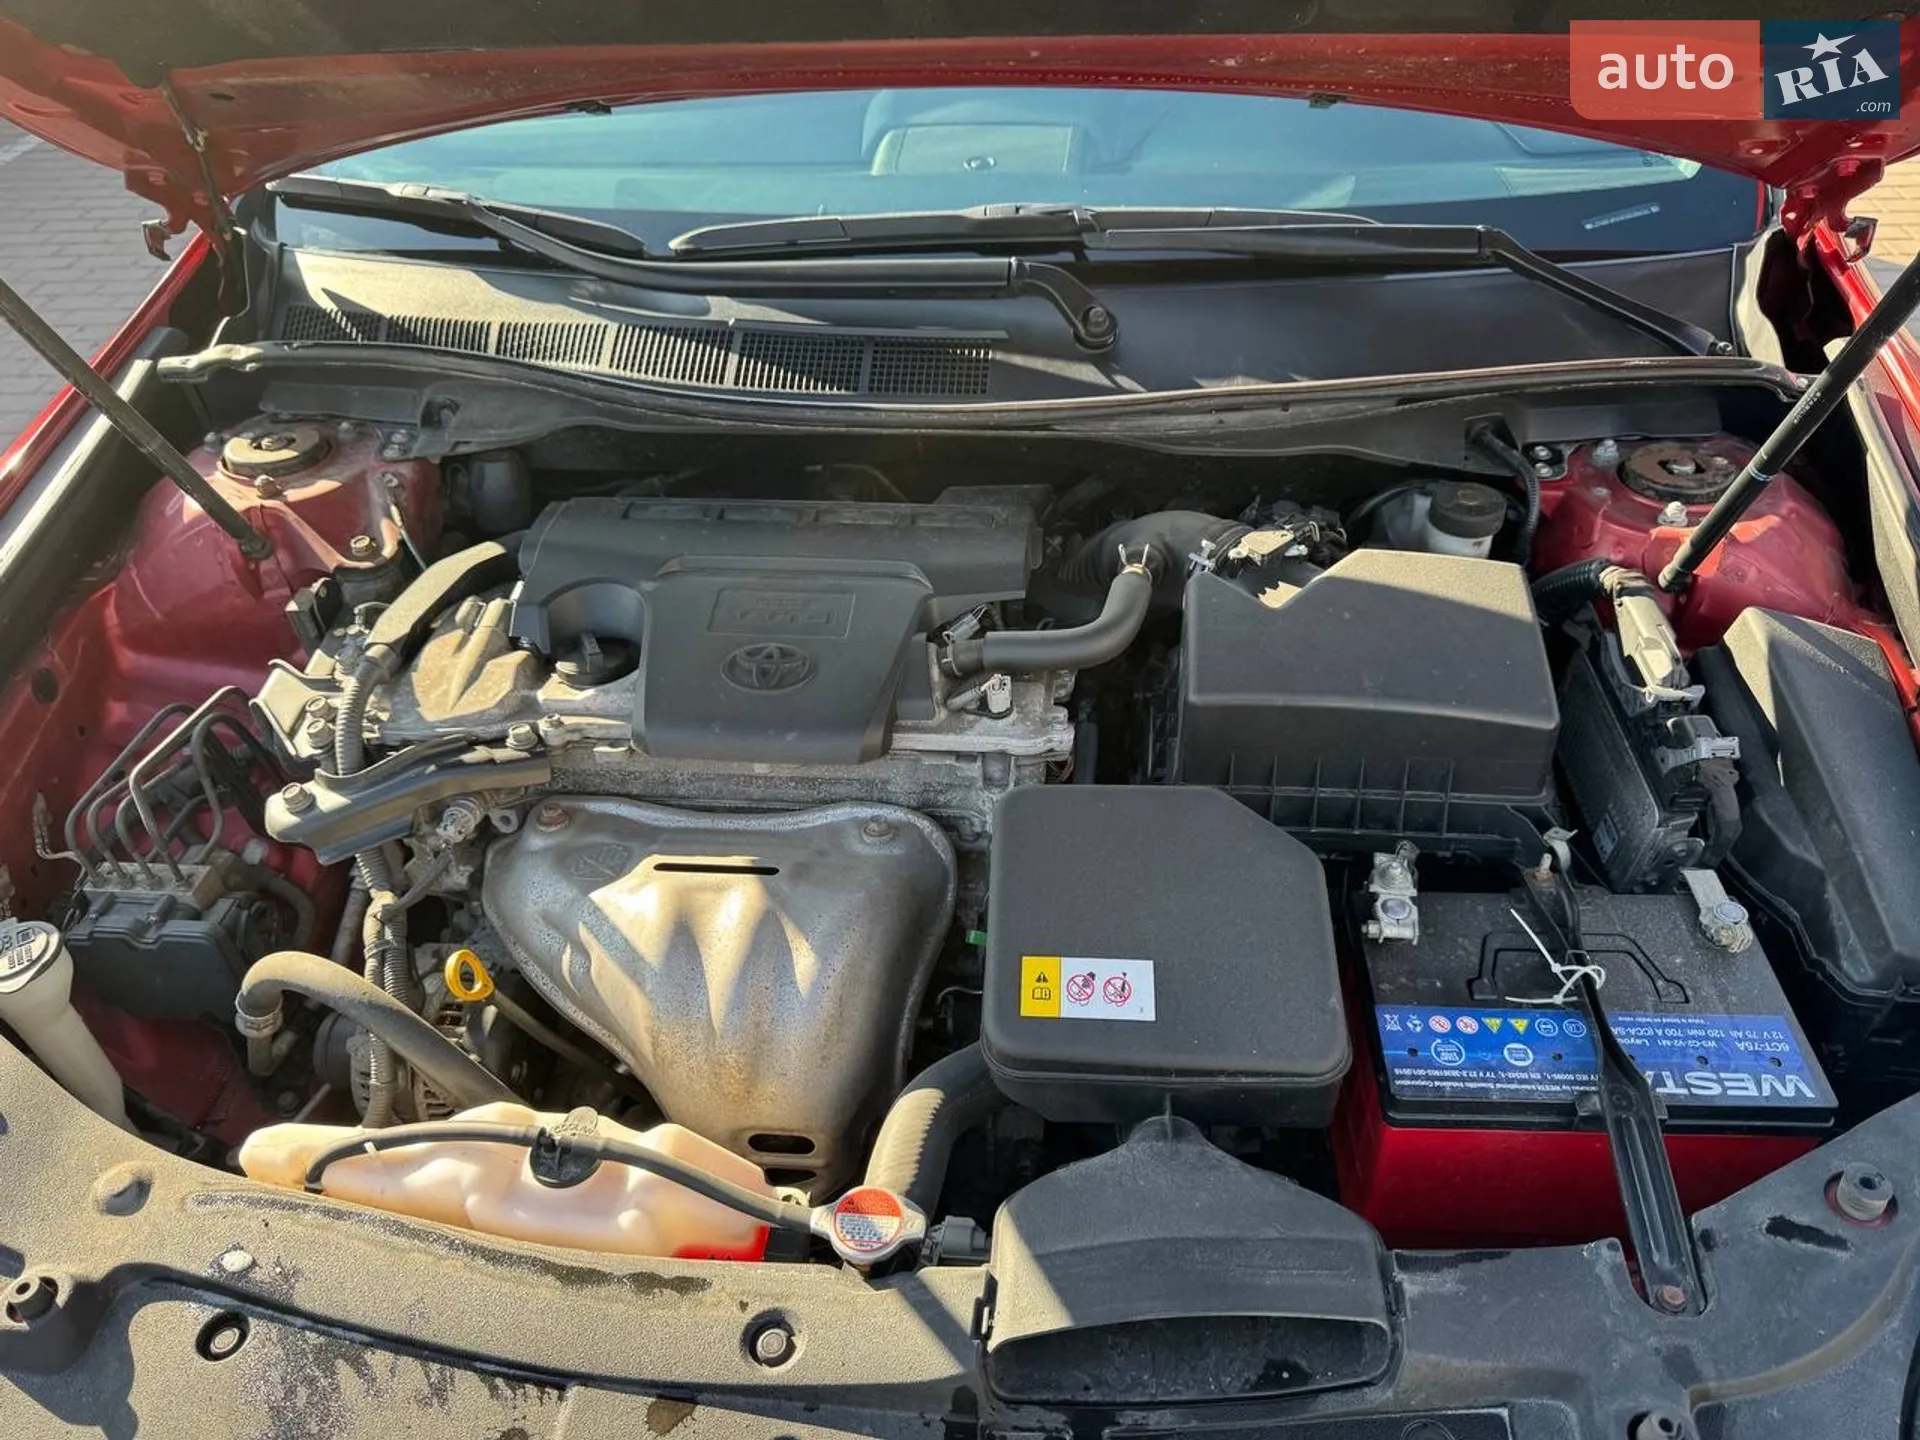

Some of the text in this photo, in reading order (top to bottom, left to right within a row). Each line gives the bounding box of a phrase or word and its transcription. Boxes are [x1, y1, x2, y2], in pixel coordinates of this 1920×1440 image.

[1610, 1026, 1654, 1036] (CCA-SA
[1665, 1028, 1684, 1037] 700
[1707, 1028, 1725, 1038] 120
[1616, 1037, 1650, 1046] Layou
